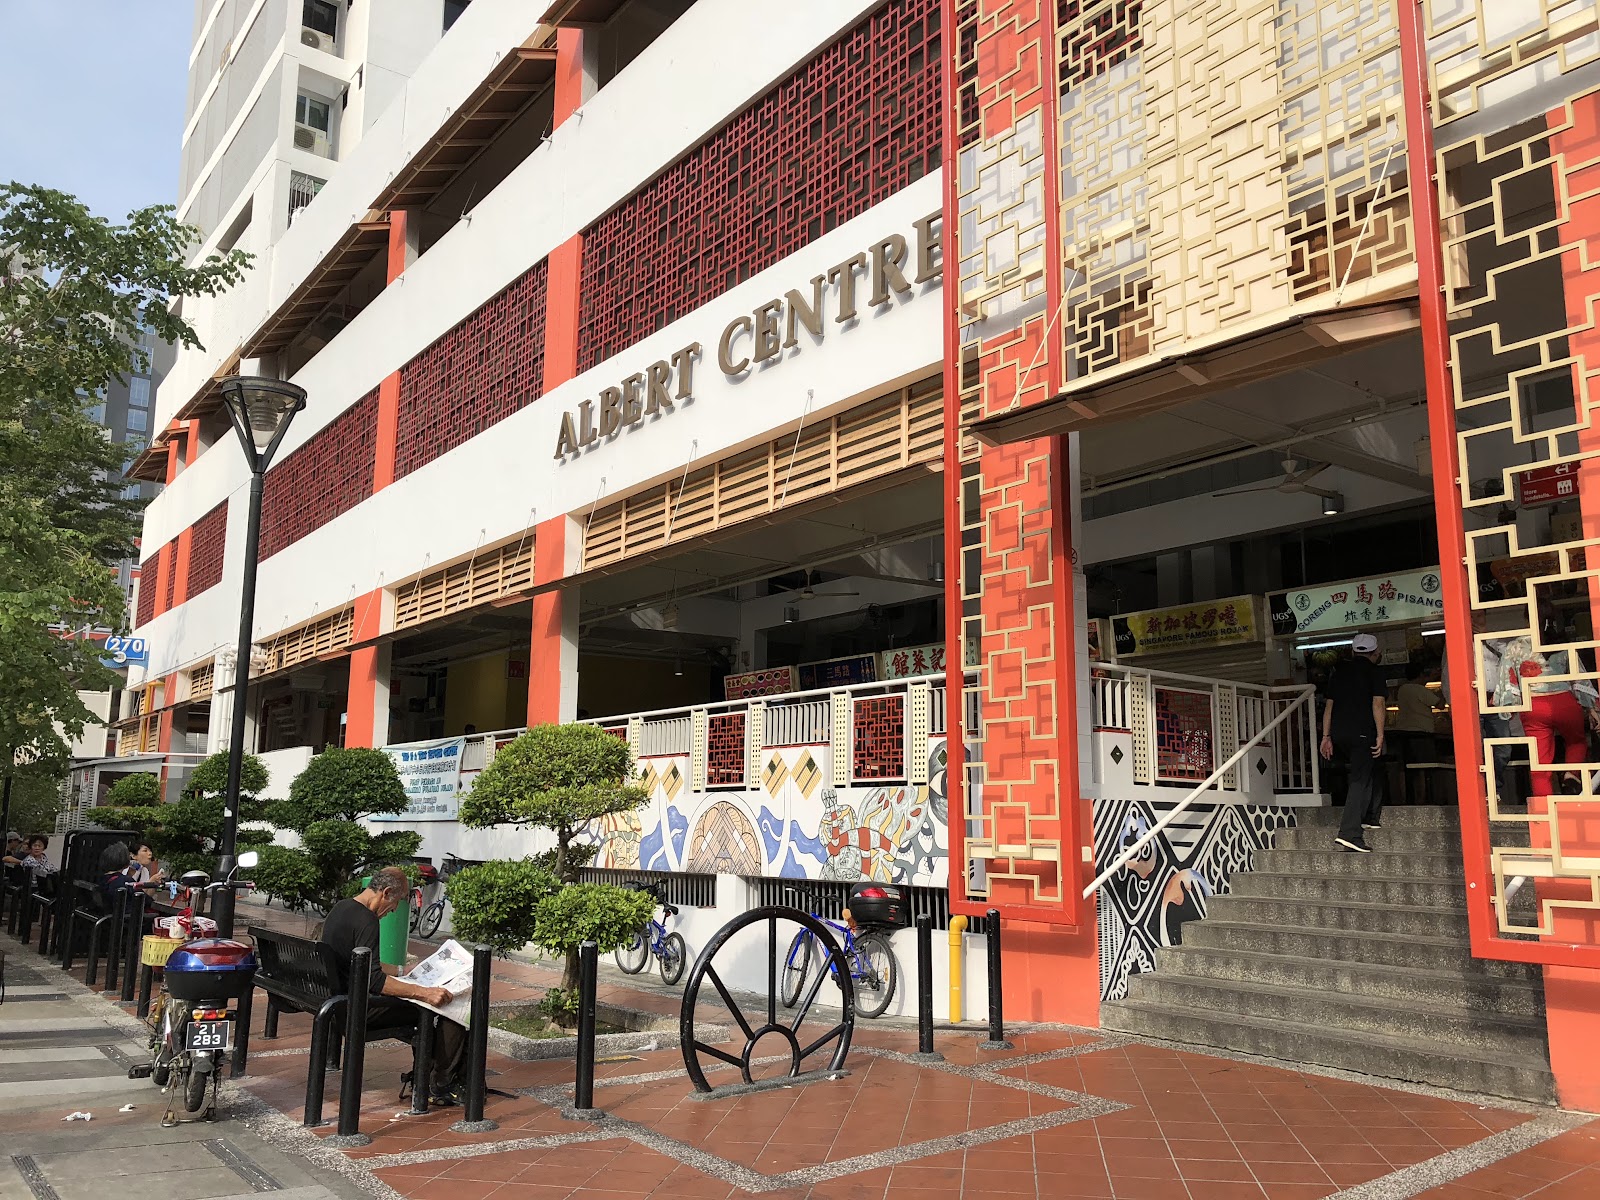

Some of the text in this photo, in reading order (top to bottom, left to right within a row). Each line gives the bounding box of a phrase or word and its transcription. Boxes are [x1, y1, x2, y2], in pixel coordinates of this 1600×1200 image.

[554, 209, 943, 459] ALBERT CENTRE
[1330, 580, 1398, 605] 四馬路
[1480, 583, 1494, 593] GS
[1397, 592, 1443, 608] PISANG
[1272, 612, 1289, 621] UGS
[1298, 600, 1332, 631] GORENG
[1345, 606, 1389, 623] 炸香蕉
[1115, 634, 1130, 642] UGS
[1139, 634, 1183, 646] SINGAPORE
[1185, 629, 1218, 640] FAMOUS
[1220, 625, 1249, 636] ROJAK
[109, 638, 143, 653] 270
[199, 1024, 216, 1035] 21
[192, 1034, 221, 1046] 283
